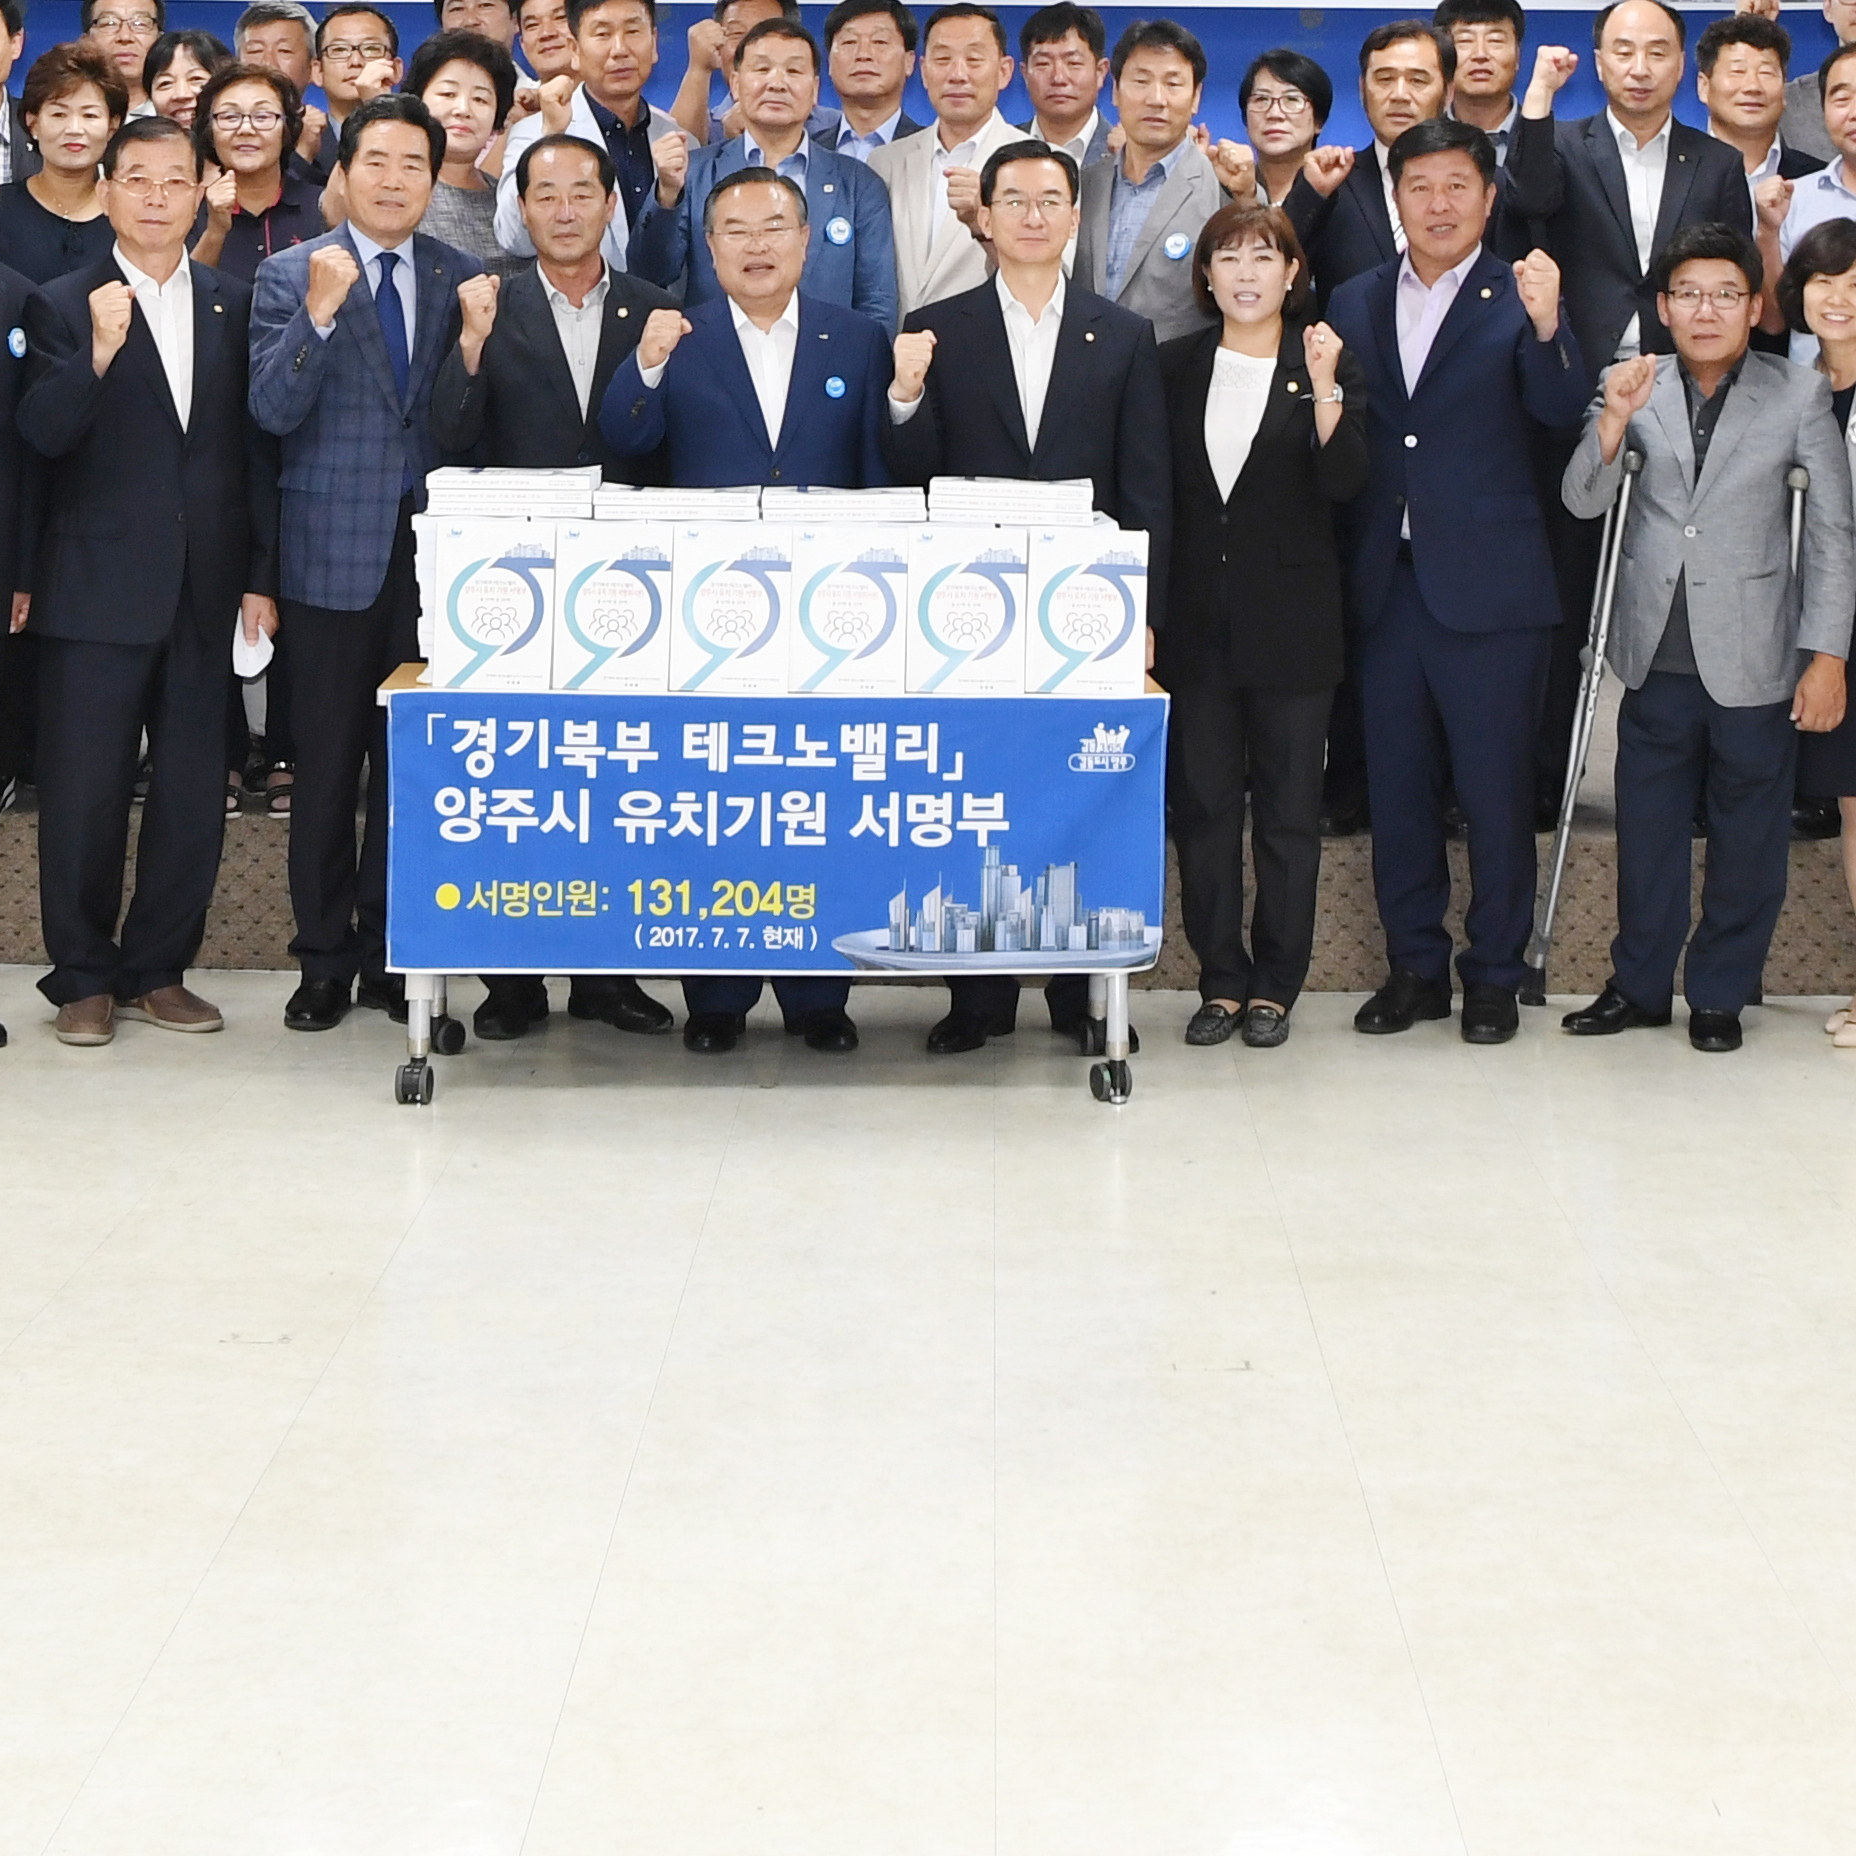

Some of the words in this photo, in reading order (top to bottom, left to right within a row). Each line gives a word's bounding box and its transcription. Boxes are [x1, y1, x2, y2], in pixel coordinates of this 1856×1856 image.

[434, 786, 591, 844] 양주시
[613, 790, 827, 847] 유치기원
[849, 791, 1011, 849] 서명부
[467, 879, 610, 918] 서명인원:
[627, 879, 817, 921] 131,204명
